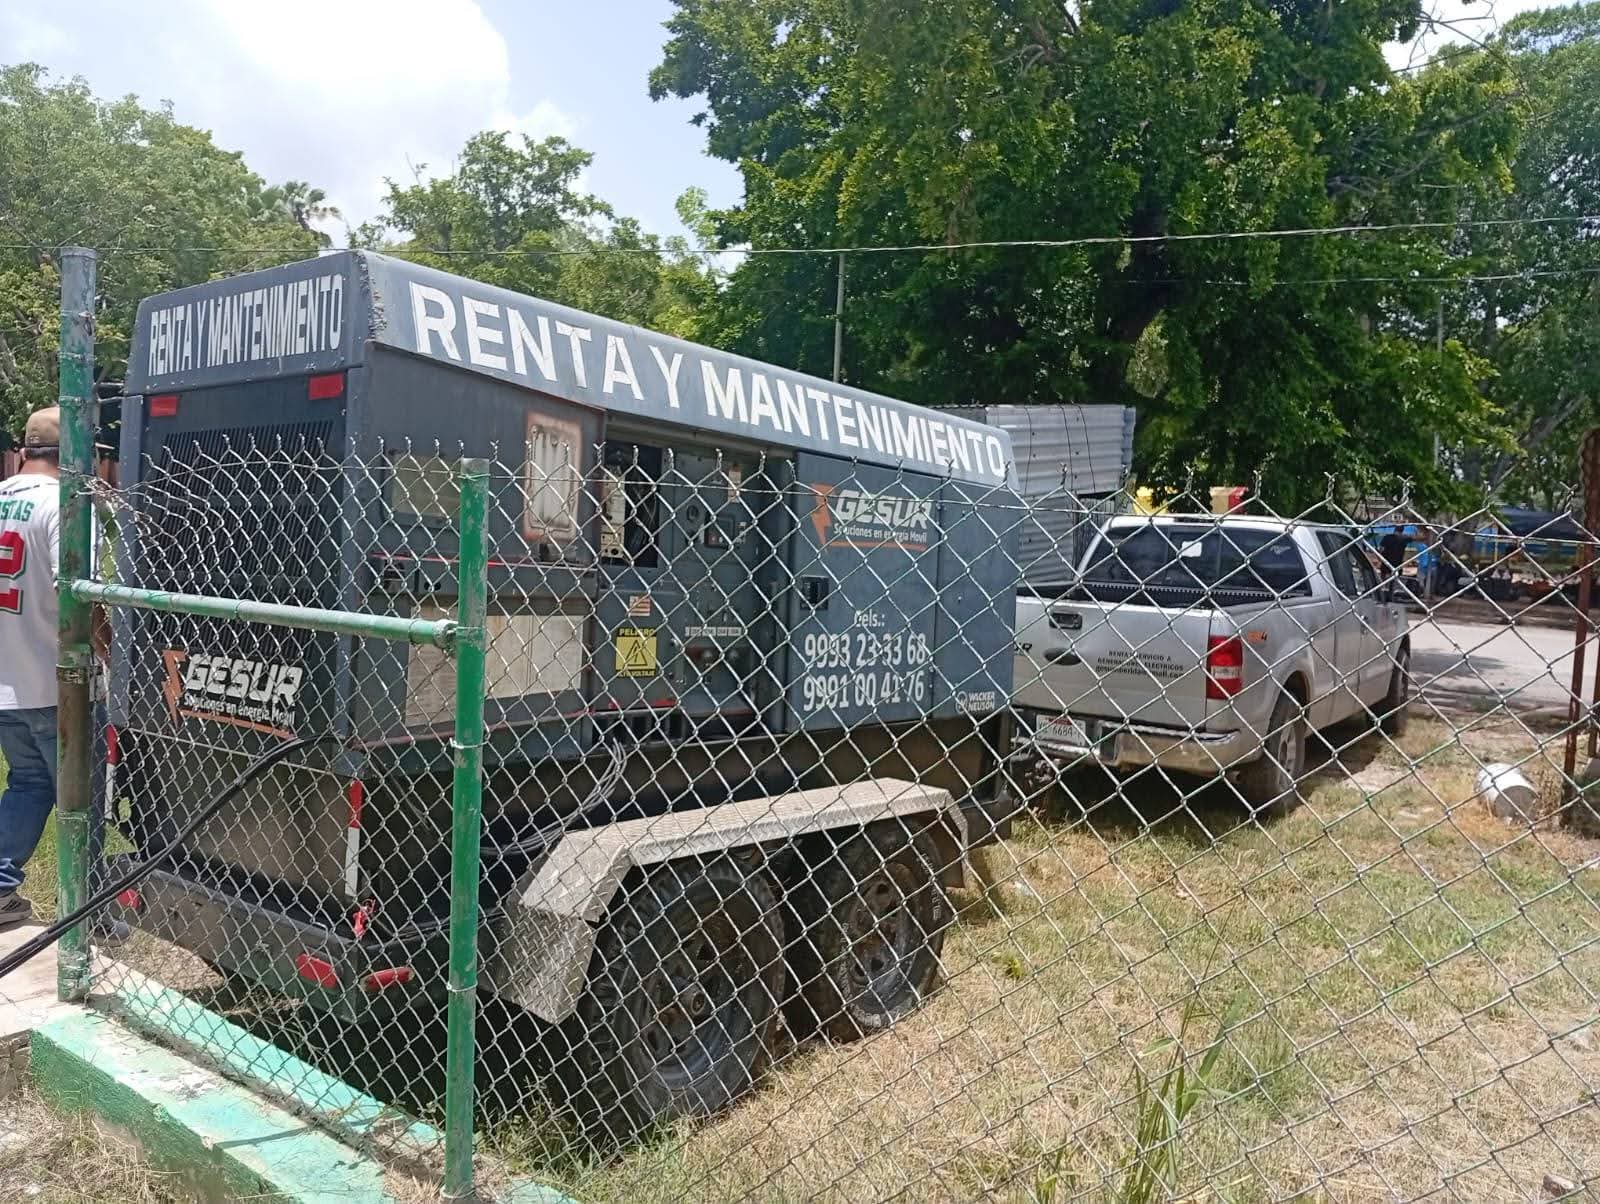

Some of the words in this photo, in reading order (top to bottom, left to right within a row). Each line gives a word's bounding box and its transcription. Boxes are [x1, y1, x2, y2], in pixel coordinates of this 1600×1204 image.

[148, 303, 193, 377] RENTA
[196, 298, 209, 368] Y
[207, 274, 344, 367] MANTENIMIENTO
[408, 281, 645, 401] RENTA
[649, 344, 684, 409] Y
[700, 359, 1006, 477] MANTENIMIENTO
[0, 498, 34, 522] STAS
[835, 489, 932, 530] GESUR
[804, 634, 851, 669] 9993
[856, 633, 877, 666] 23
[882, 634, 902, 666] 33
[907, 633, 926, 665] 68
[185, 653, 303, 707] GESUR
[803, 672, 849, 711] 9991
[855, 672, 876, 706] 00
[880, 671, 901, 705] 41
[907, 669, 925, 702] 76
